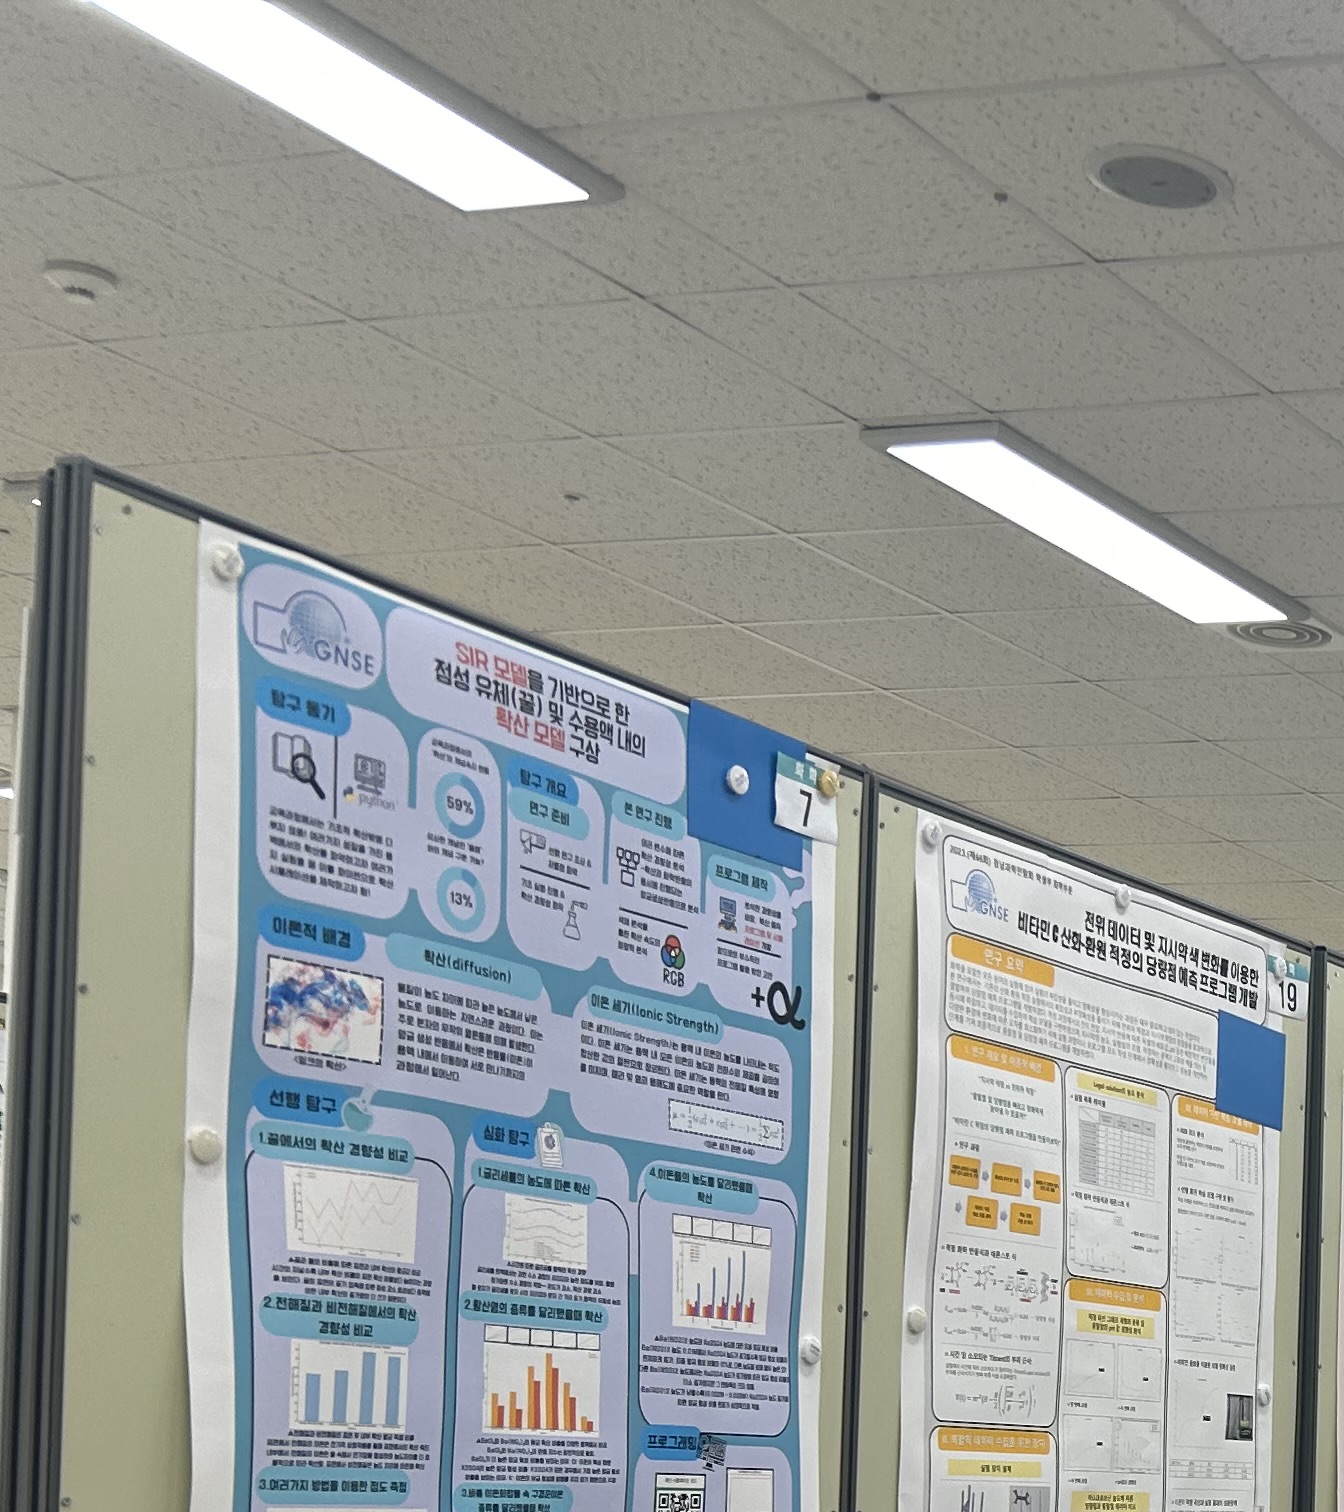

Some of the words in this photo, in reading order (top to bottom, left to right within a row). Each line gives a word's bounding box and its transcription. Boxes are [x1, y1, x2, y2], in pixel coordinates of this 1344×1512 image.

[314, 640, 375, 677] GNSE
[455, 641, 489, 672] SIR
[494, 655, 544, 694] 모델을
[548, 675, 611, 720] 기반으로
[614, 702, 630, 727] 한
[434, 658, 470, 692] 점성
[548, 701, 564, 727] 및
[569, 711, 614, 745] 수용액
[617, 727, 646, 759] 내의
[496, 707, 529, 739] 확산
[534, 721, 566, 753] 모델
[569, 734, 601, 765] 구상
[519, 768, 542, 788] 탐구
[545, 778, 568, 798] 개요
[446, 796, 474, 815] 59%
[529, 801, 549, 818] 연구
[635, 804, 653, 822] 연구
[799, 788, 813, 827] 7
[715, 864, 750, 886] 프로그램
[449, 891, 474, 909] 13%
[979, 903, 1009, 923] GNSE
[272, 916, 317, 940] 이론적
[1017, 910, 1051, 943] 비타민
[1052, 924, 1059, 942] C
[1061, 926, 1107, 961] 산화-환원
[1109, 943, 1143, 972] 적정의
[1146, 956, 1176, 984] 당량점
[1178, 964, 1198, 990] 예측
[1199, 972, 1236, 1003] 프로그램
[1238, 986, 1258, 1010] 개발
[1084, 910, 1106, 934] 전위
[1107, 921, 1141, 949] 데이터
[1143, 931, 1155, 952] 및
[1157, 934, 1189, 960] 지시약
[1190, 945, 1199, 961] 색
[1201, 950, 1229, 979] 변화를
[1231, 961, 1259, 989] 이용한
[423, 948, 512, 984] 확산(diffusion)
[663, 968, 685, 988] RGB
[1279, 981, 1297, 1012] 19
[590, 992, 610, 1010] 이온
[666, 1011, 719, 1035] Strength)
[269, 1089, 300, 1107] 선행
[306, 1095, 338, 1114] 탐구
[509, 1129, 529, 1146] 탐구
[321, 1138, 345, 1155] 확산
[349, 1141, 384, 1159] 경향성
[388, 1147, 409, 1163] 비교
[574, 1182, 591, 1196] 확산
[263, 1296, 322, 1313] 2.전해질과
[398, 1307, 416, 1322] 확산
[585, 1309, 603, 1323] 확산
[318, 1321, 351, 1336] 경향성
[353, 1324, 374, 1338] 비교
